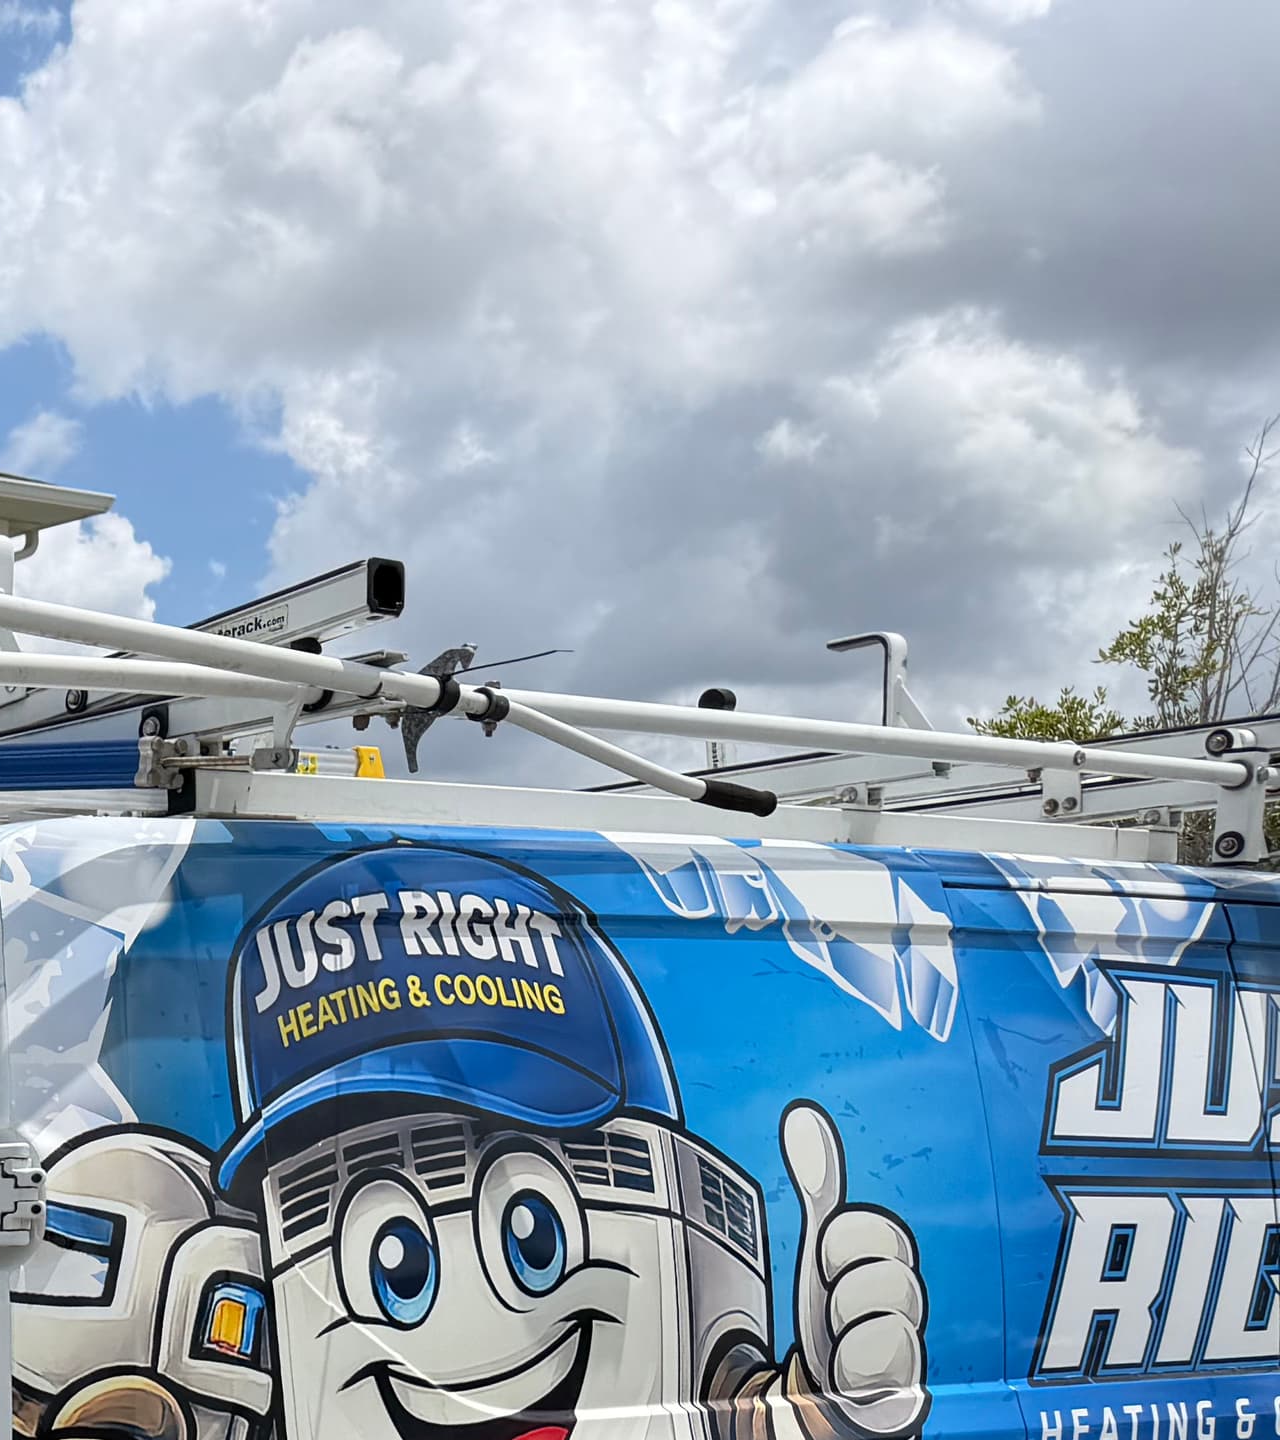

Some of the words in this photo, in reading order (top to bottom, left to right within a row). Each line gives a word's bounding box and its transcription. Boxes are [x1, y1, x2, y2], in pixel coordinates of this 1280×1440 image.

[254, 892, 389, 1014] JUST
[398, 890, 565, 977] RIGHT
[277, 977, 401, 1048] HEATING
[407, 975, 431, 1008] &
[434, 974, 566, 1015] COOLING
[1235, 1397, 1256, 1440] &
